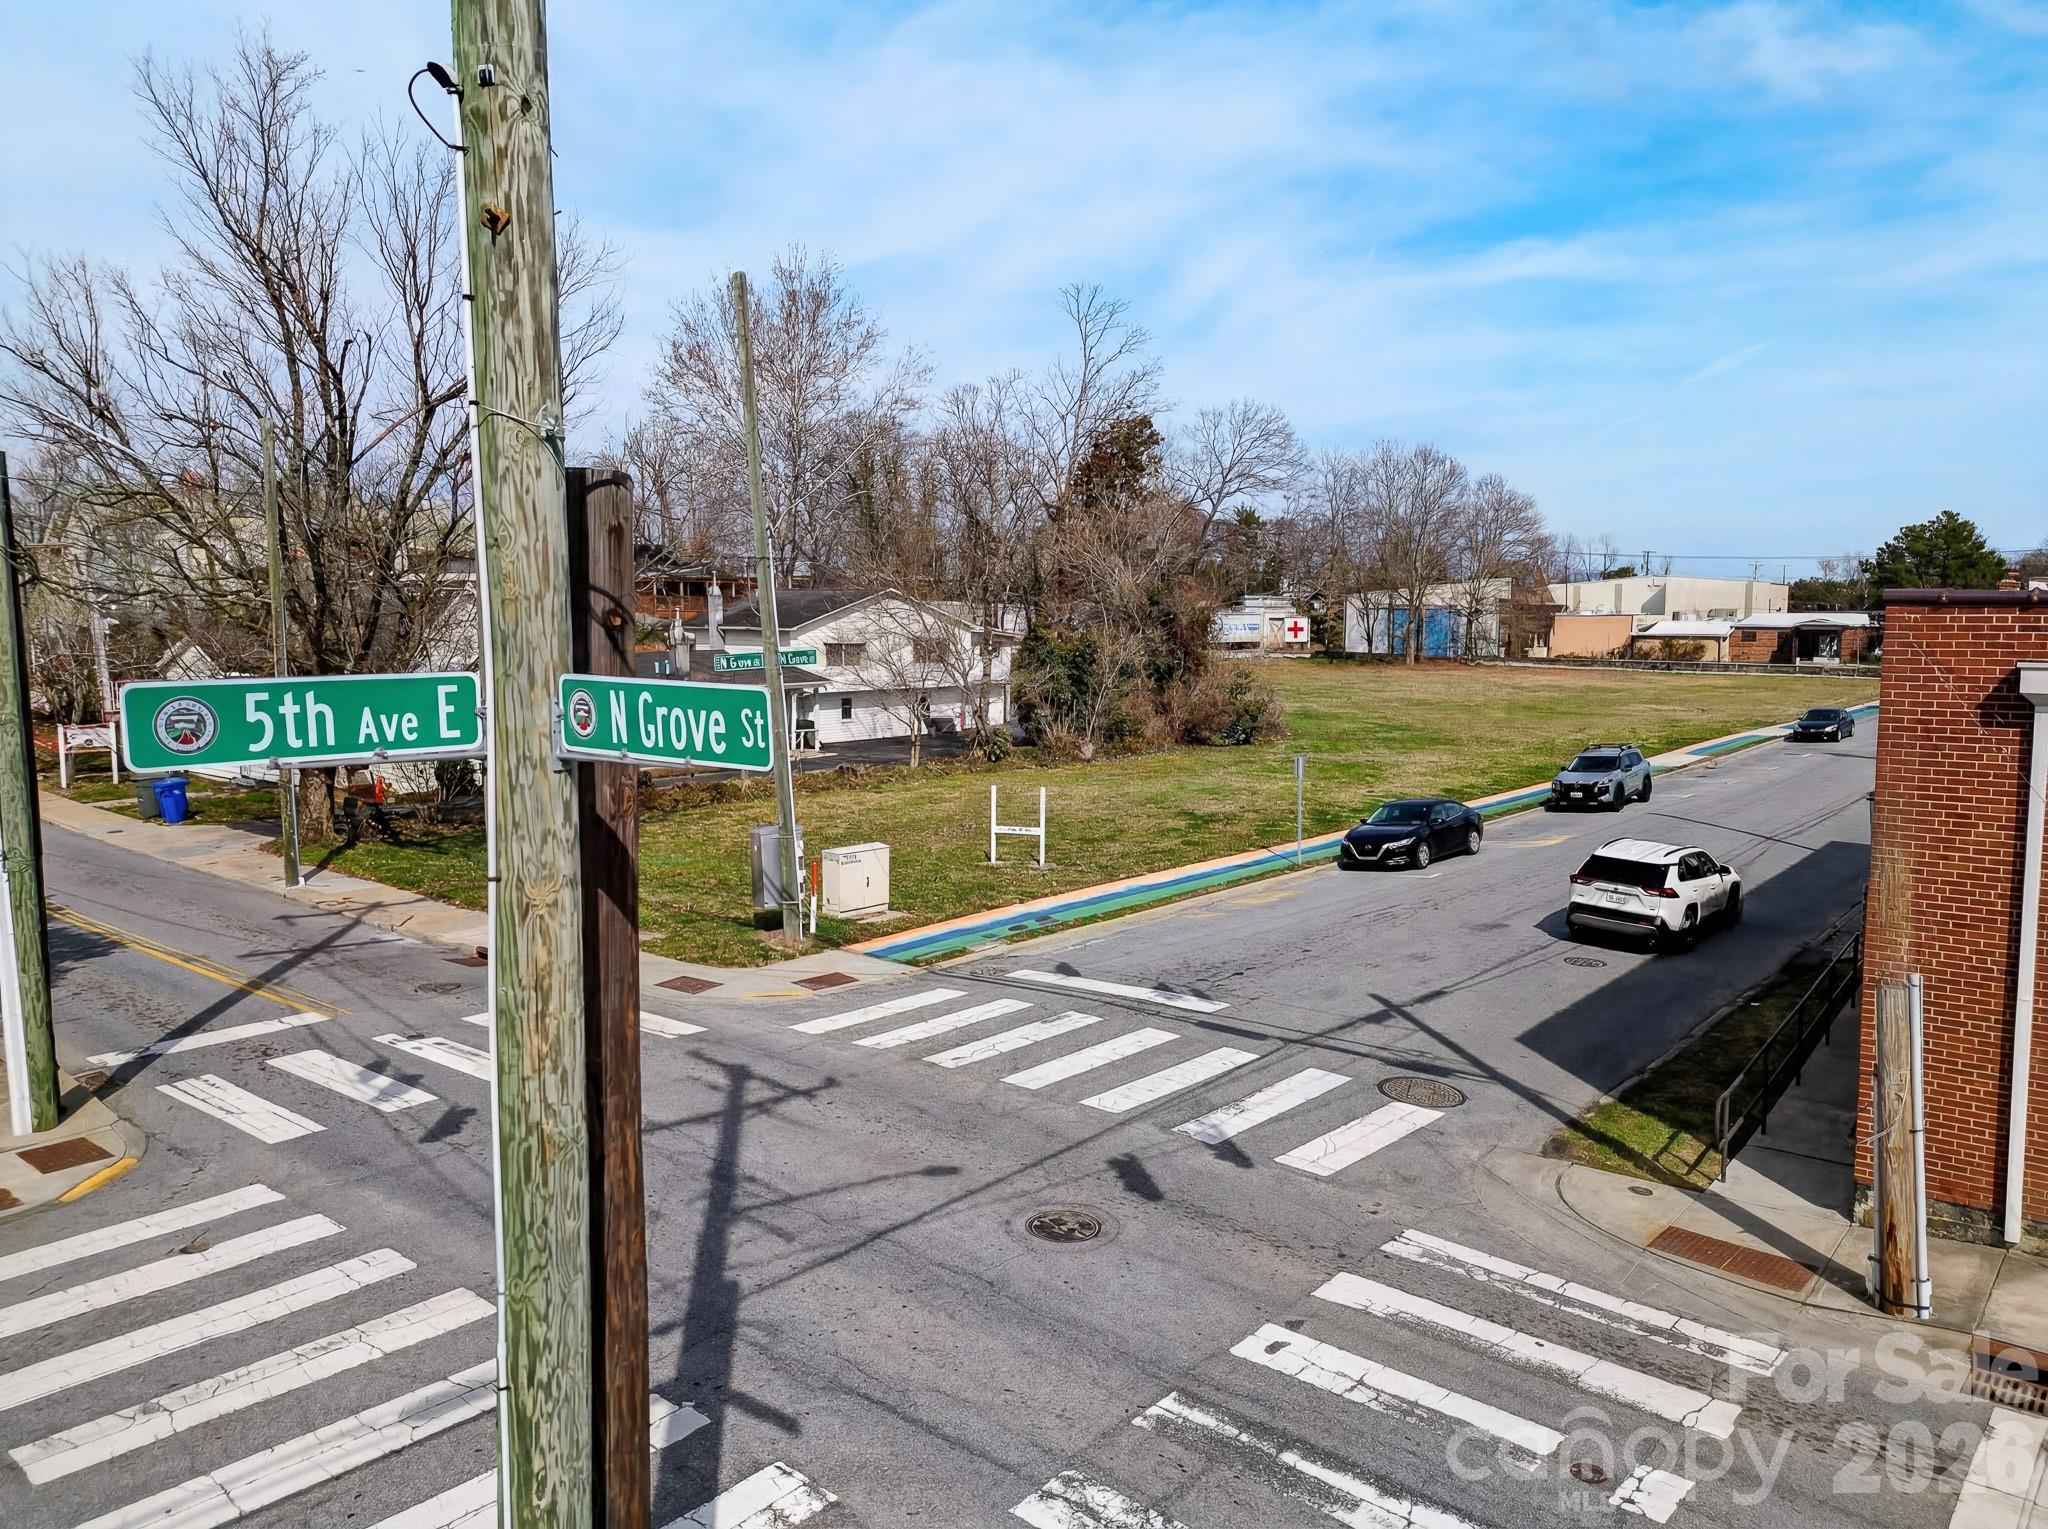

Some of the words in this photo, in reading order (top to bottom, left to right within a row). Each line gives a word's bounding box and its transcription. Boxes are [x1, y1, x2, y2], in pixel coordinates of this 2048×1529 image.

[245, 691, 336, 752] 5th
[358, 706, 418, 745] Ave
[438, 684, 461, 739] E
[609, 689, 628, 744] N
[638, 691, 727, 754] Grove
[740, 707, 767, 749] St
